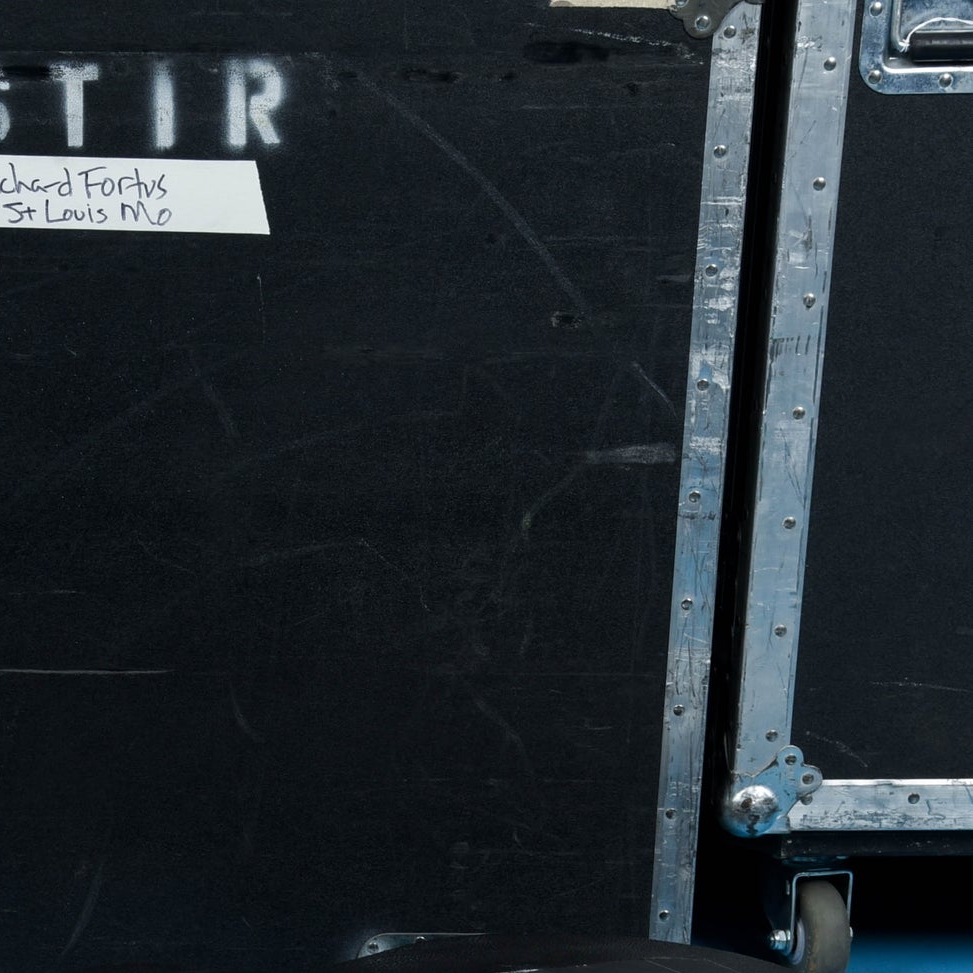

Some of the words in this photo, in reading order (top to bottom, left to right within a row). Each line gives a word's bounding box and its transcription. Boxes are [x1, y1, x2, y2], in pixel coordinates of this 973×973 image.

[78, 166, 168, 200] Fortus
[2, 202, 37, 225] St
[45, 199, 108, 224] Louis
